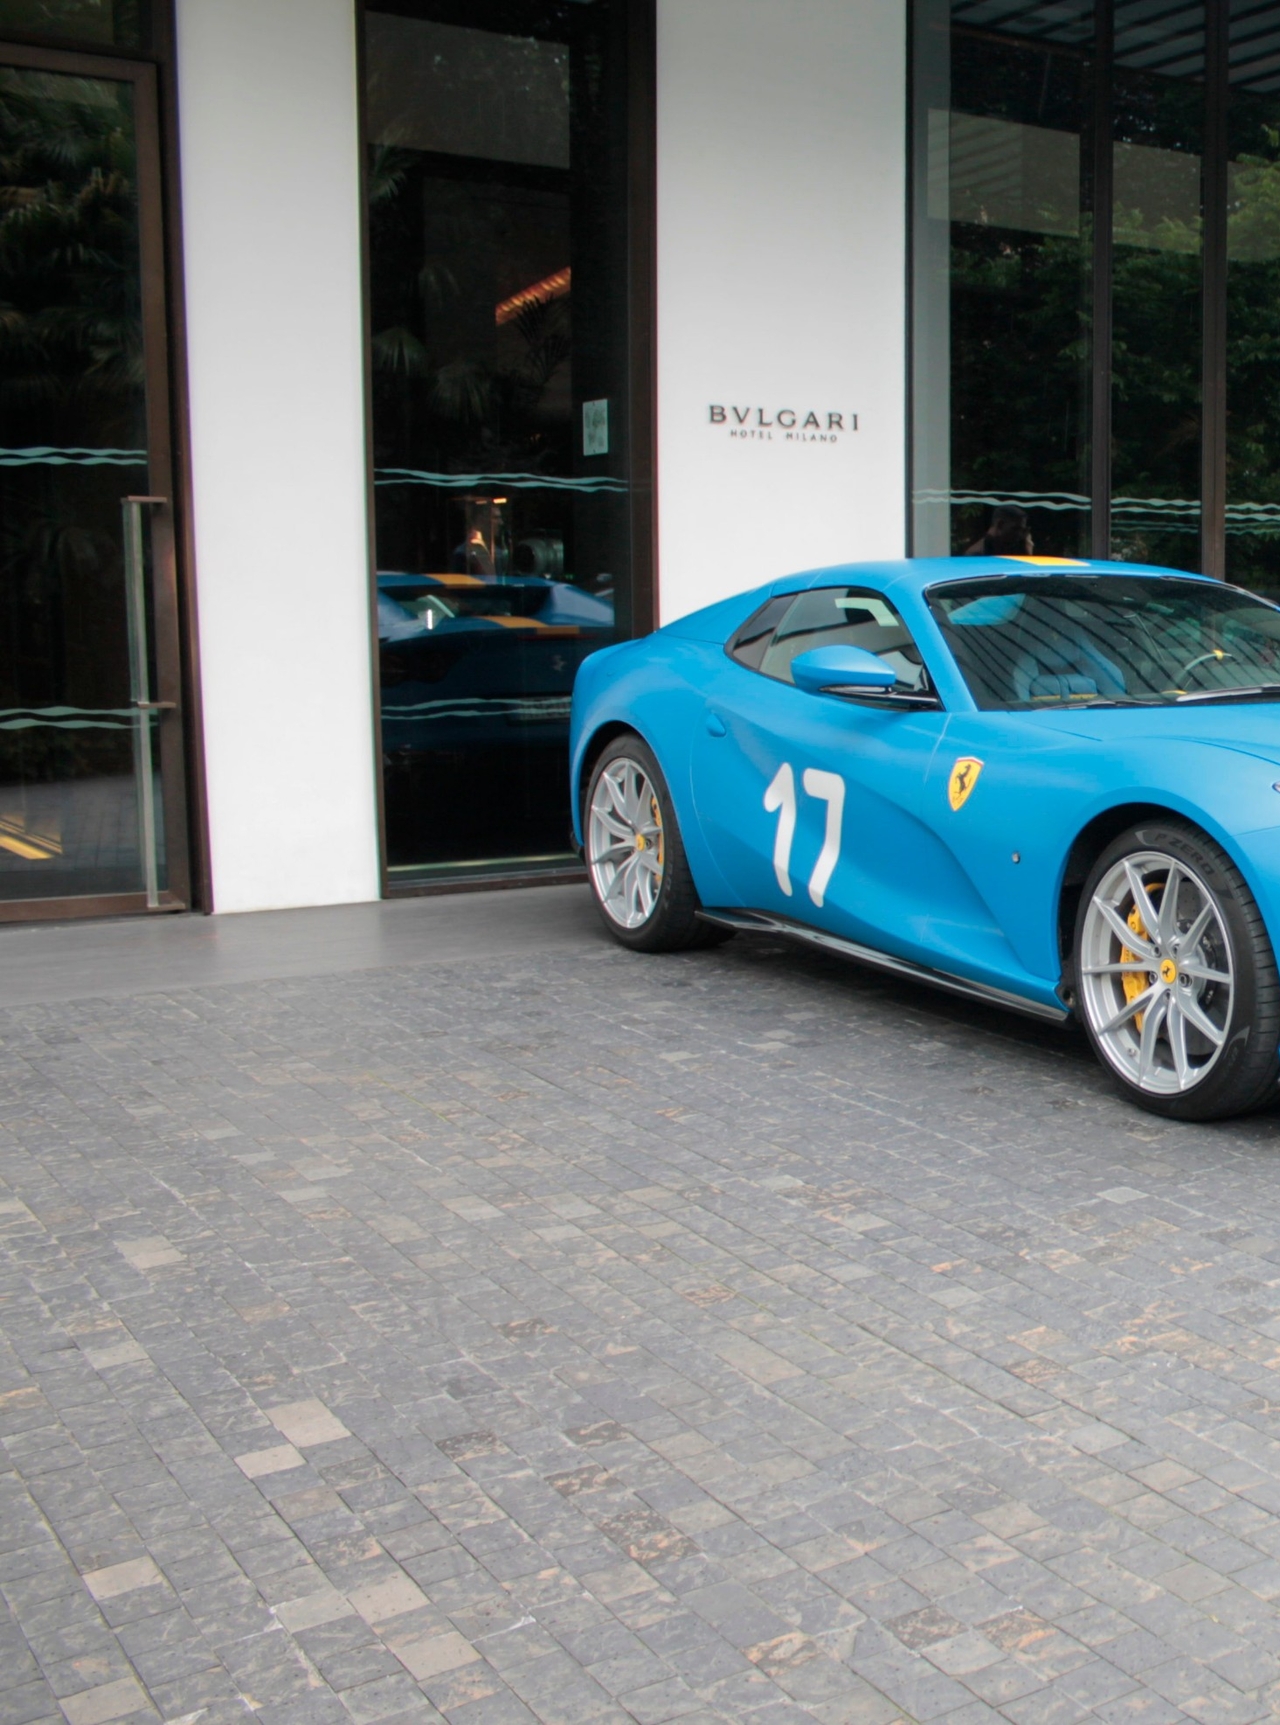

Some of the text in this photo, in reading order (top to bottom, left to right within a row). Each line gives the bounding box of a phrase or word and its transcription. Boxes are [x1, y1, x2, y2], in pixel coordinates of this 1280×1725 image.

[709, 405, 858, 431] BVLGARI
[731, 429, 838, 443] HOTEL MILANO
[763, 762, 846, 908] 17
[1168, 838, 1215, 875] ZERO
